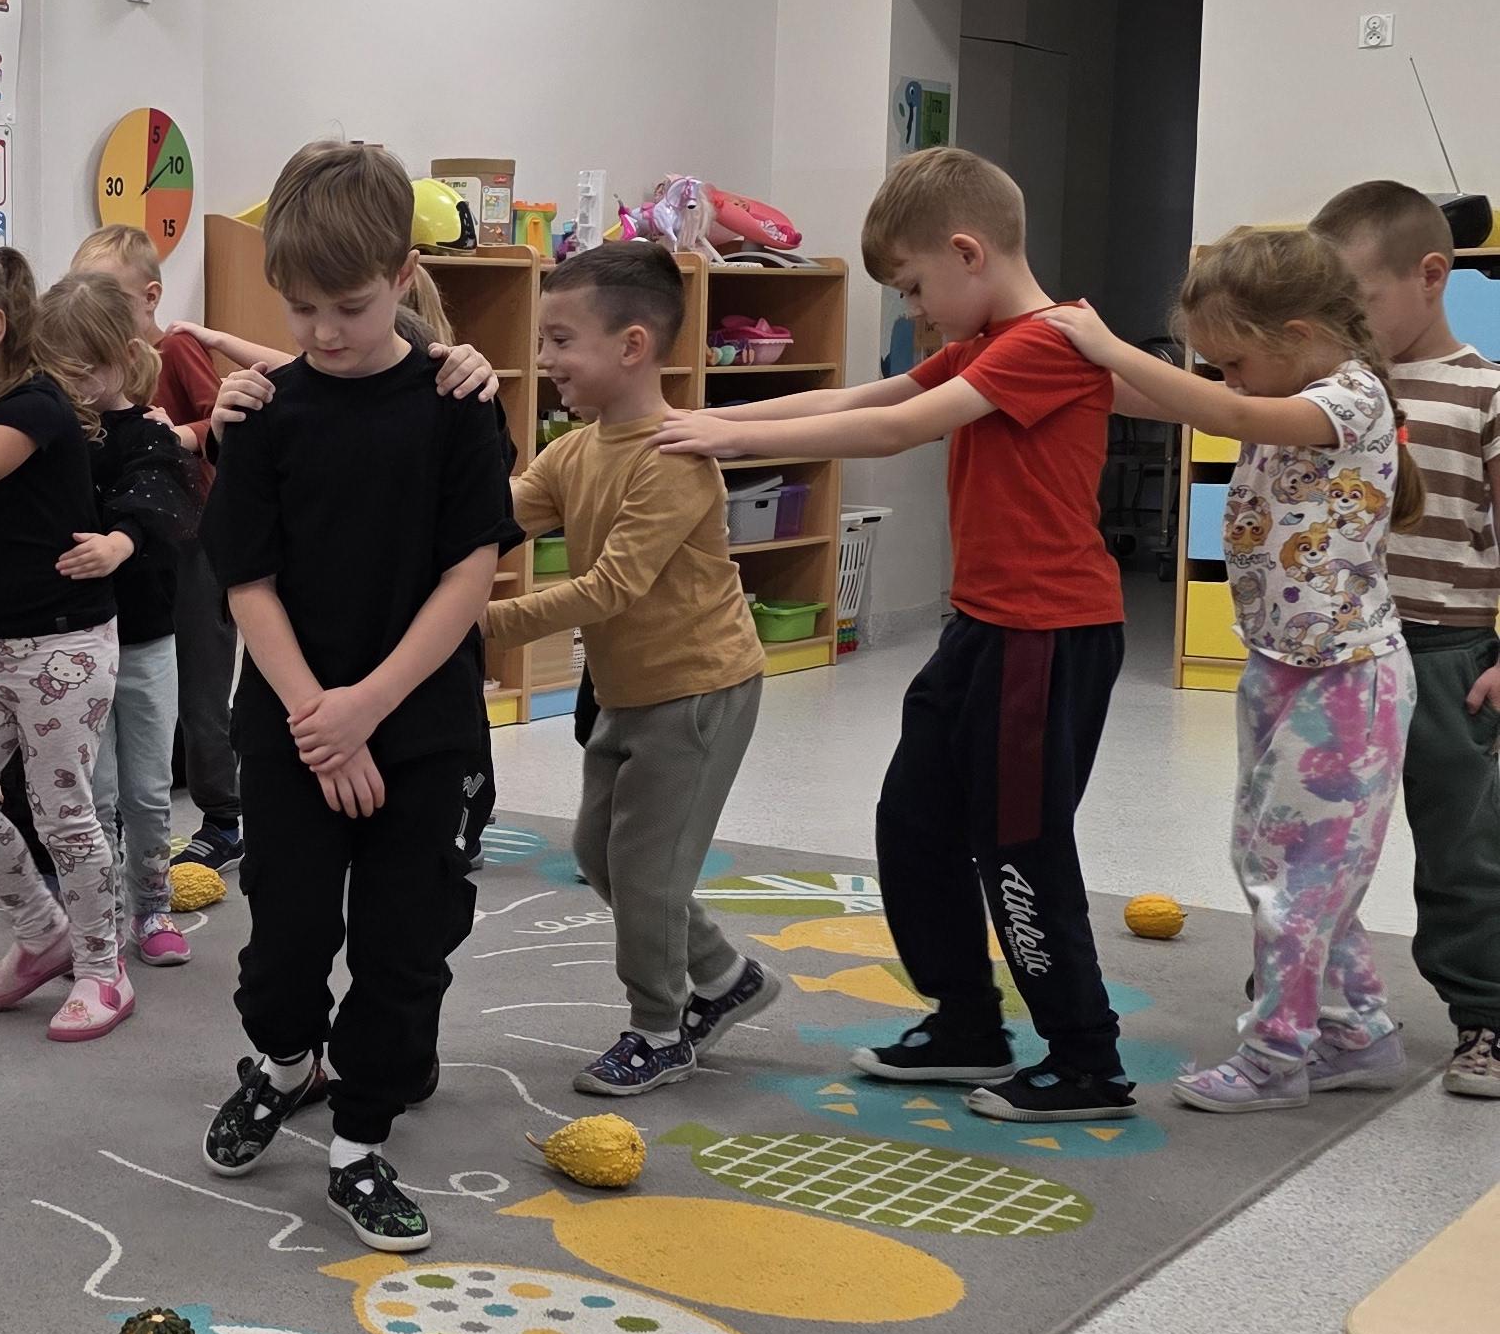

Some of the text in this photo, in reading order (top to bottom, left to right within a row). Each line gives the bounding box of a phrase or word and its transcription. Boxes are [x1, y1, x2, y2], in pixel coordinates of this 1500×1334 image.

[152, 126, 161, 144] 5
[169, 155, 184, 175] 10
[105, 177, 124, 196] 30
[162, 219, 176, 237] 15
[1001, 864, 1052, 977] Athletic
